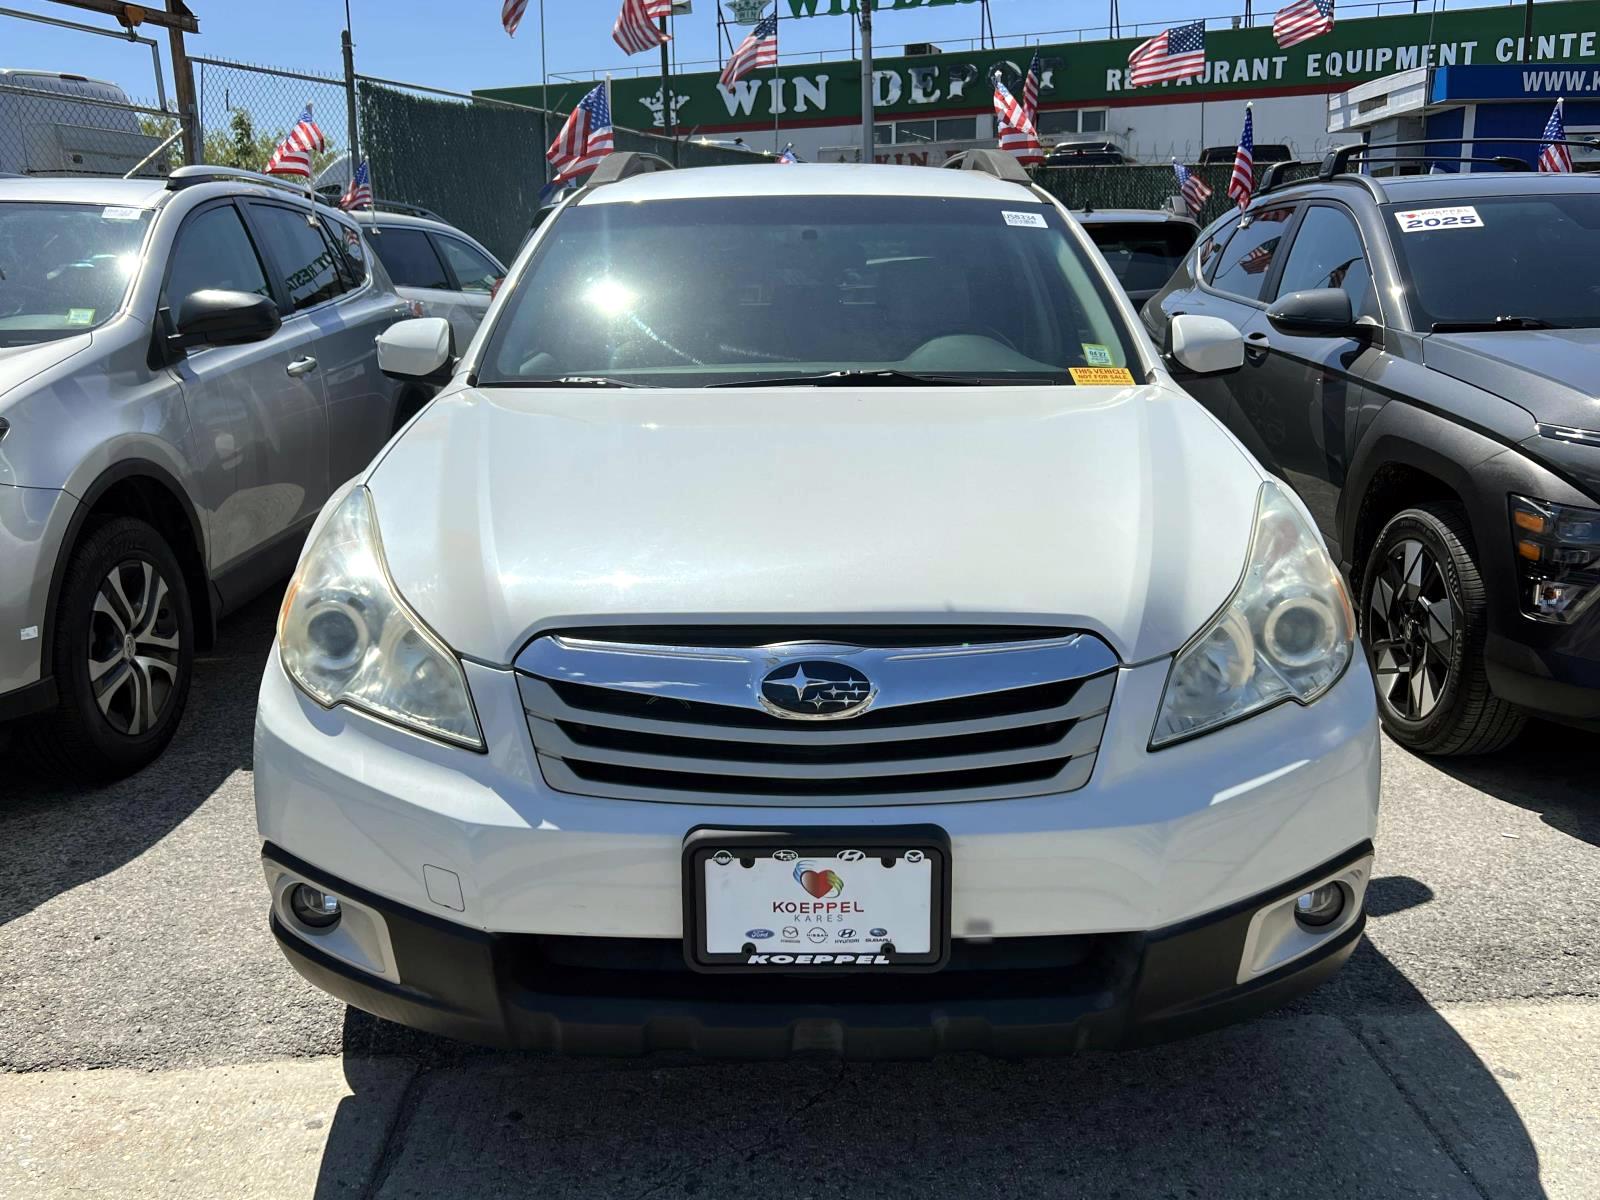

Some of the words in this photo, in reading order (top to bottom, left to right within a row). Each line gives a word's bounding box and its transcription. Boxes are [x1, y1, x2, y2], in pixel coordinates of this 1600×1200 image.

[716, 74, 829, 117] WIN
[1106, 56, 1288, 91] REURANT
[1306, 41, 1478, 78] EQUIPMENT
[1406, 215, 1477, 229] 2025
[773, 901, 865, 914] KOEPPEL
[794, 914, 843, 923] KARES
[748, 955, 890, 964] KOEPPEL
